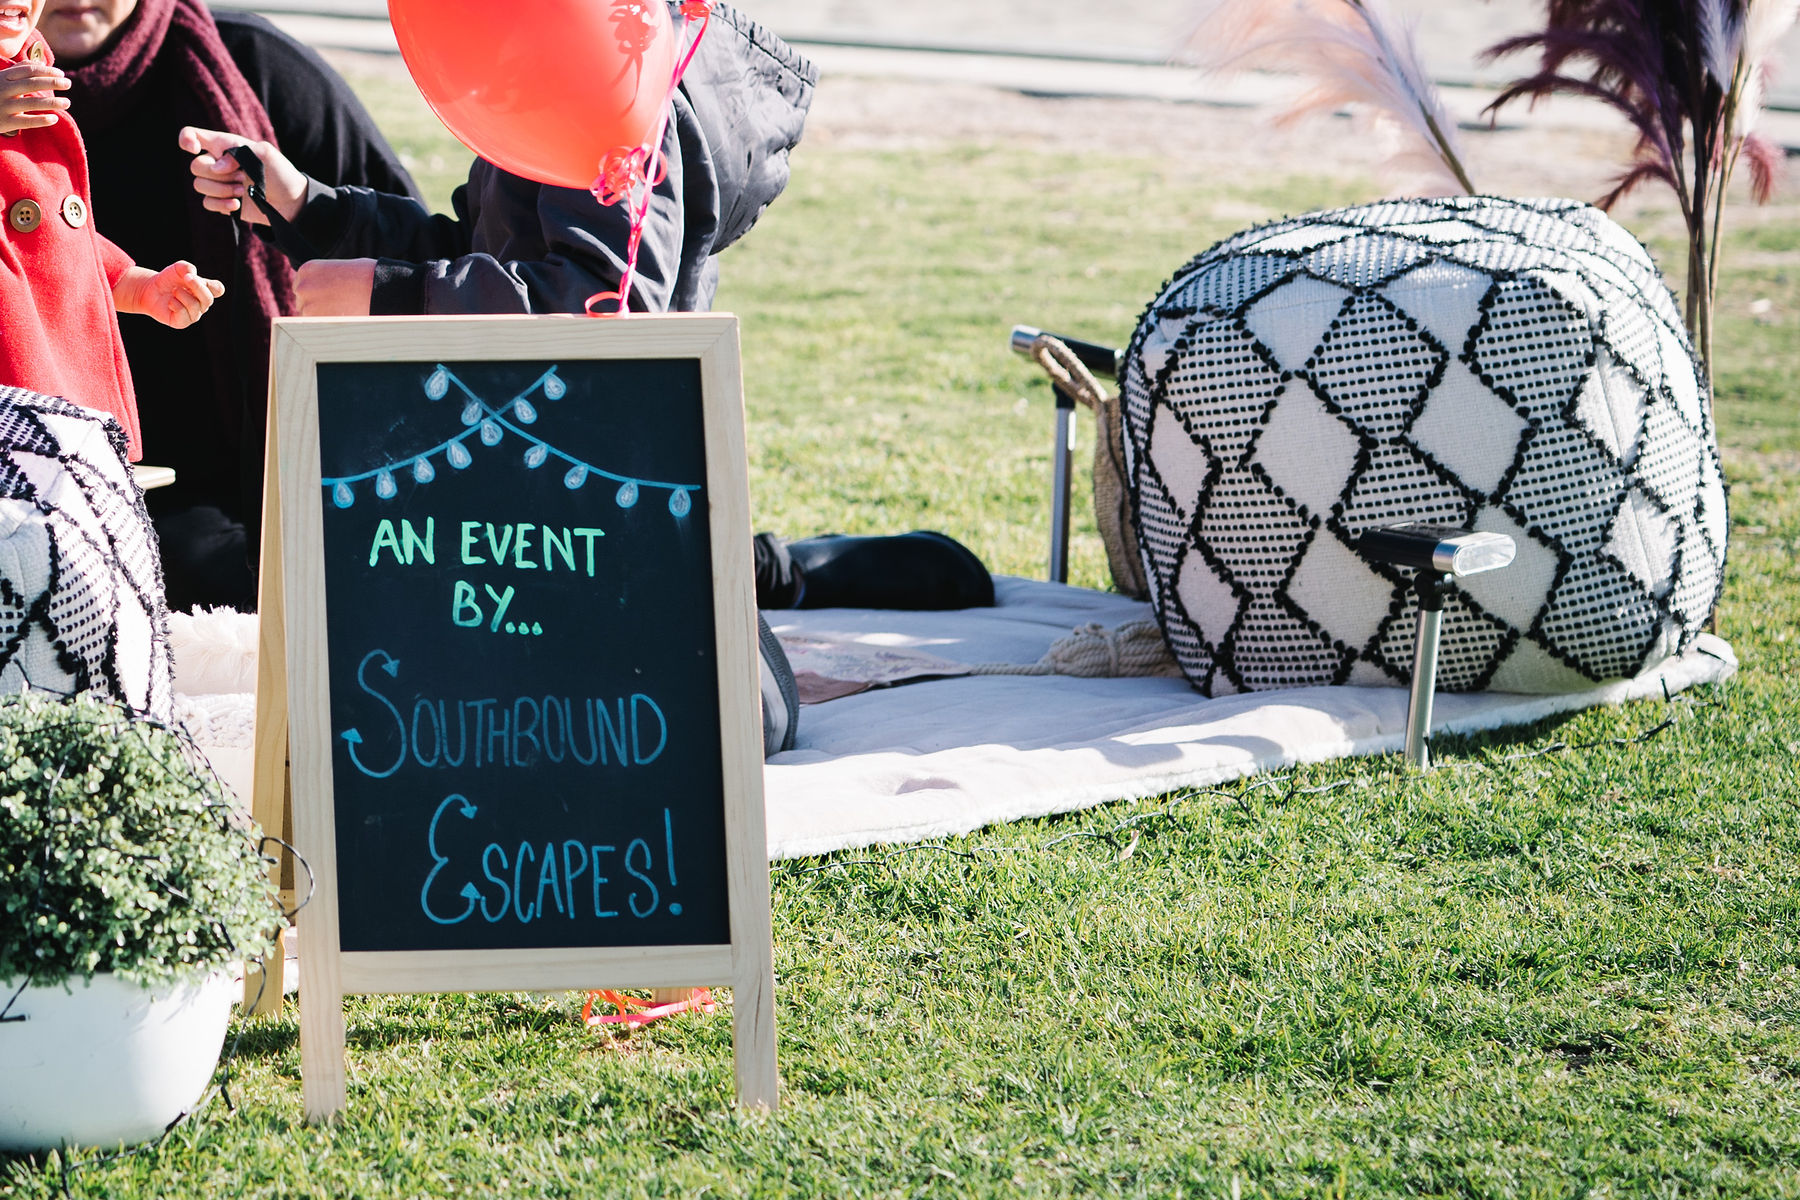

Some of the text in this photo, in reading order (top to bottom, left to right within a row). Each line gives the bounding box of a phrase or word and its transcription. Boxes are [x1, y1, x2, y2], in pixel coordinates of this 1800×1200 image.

[369, 516, 606, 577] AN EVENT
[452, 579, 545, 636] BY...
[420, 792, 685, 926] ESCAPES!
